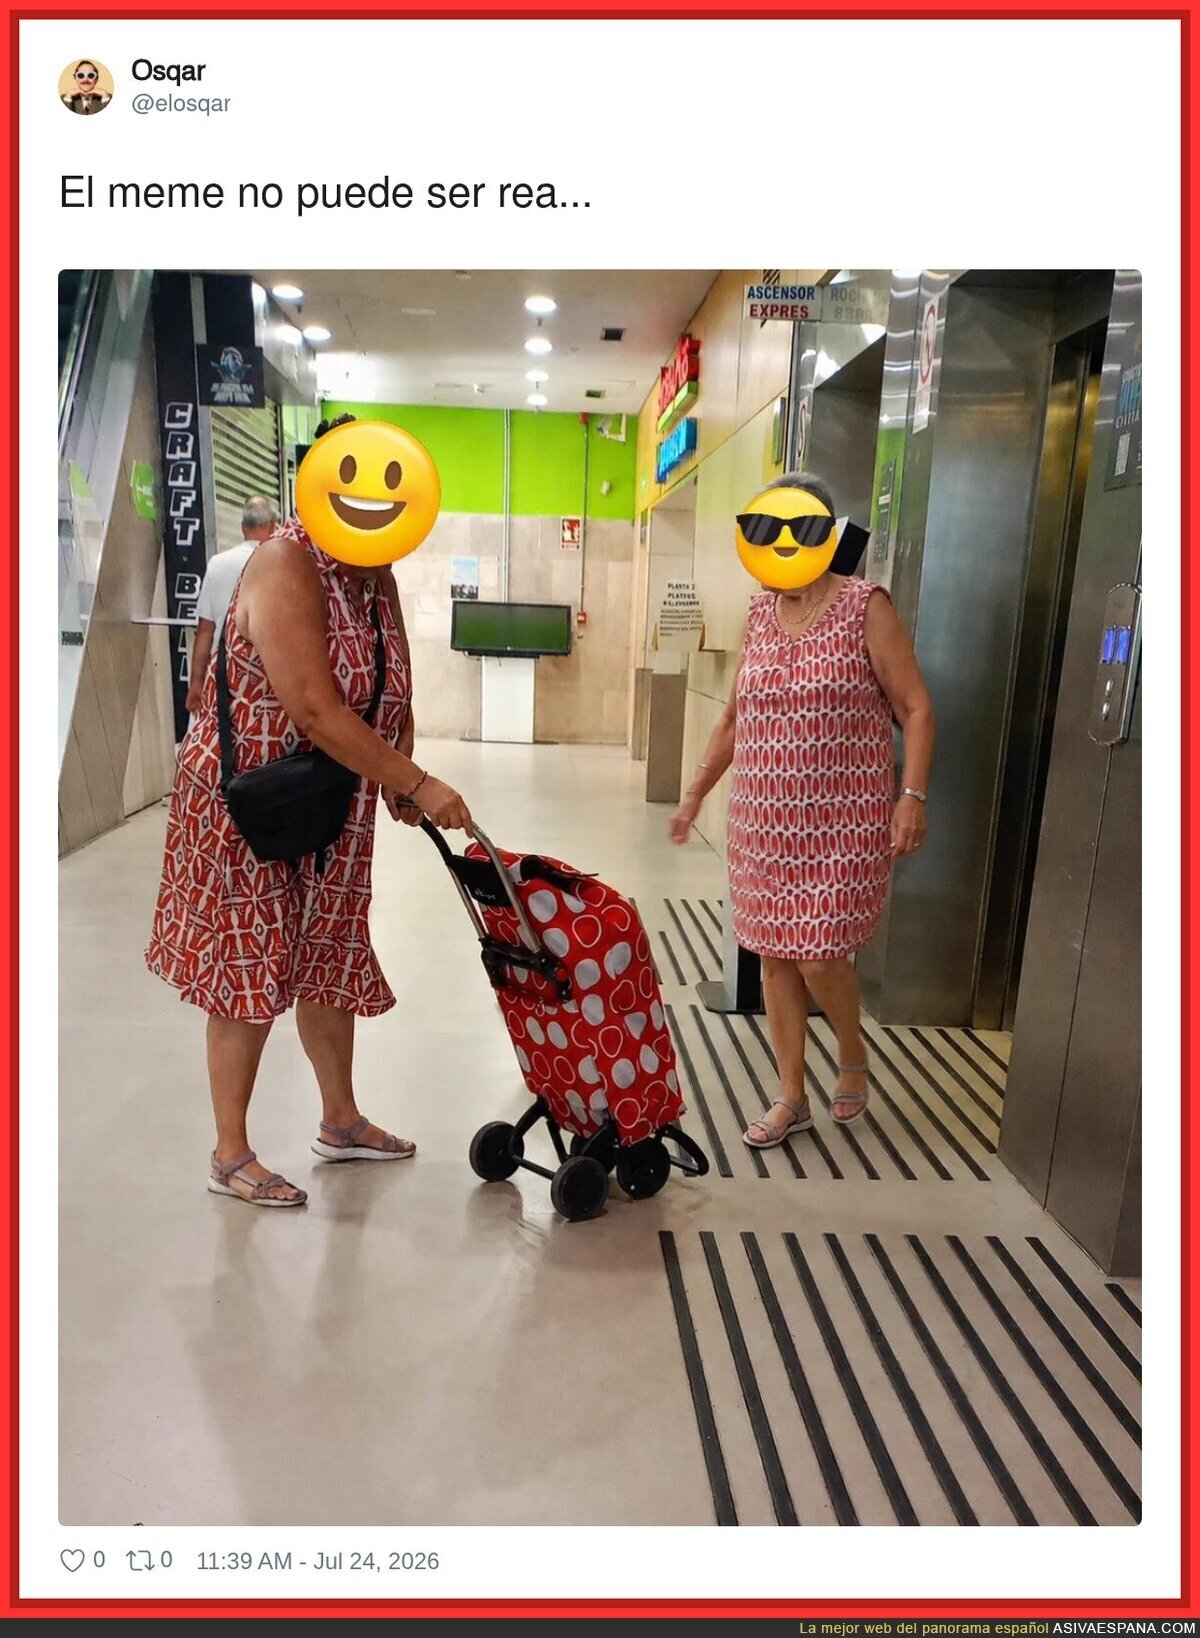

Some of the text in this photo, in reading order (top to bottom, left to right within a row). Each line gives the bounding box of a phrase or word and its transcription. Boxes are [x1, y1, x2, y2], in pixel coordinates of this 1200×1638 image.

[747, 285, 815, 300] ASCENSOR
[749, 304, 809, 319] EXPRES
[165, 402, 202, 682] CRAFT BE
